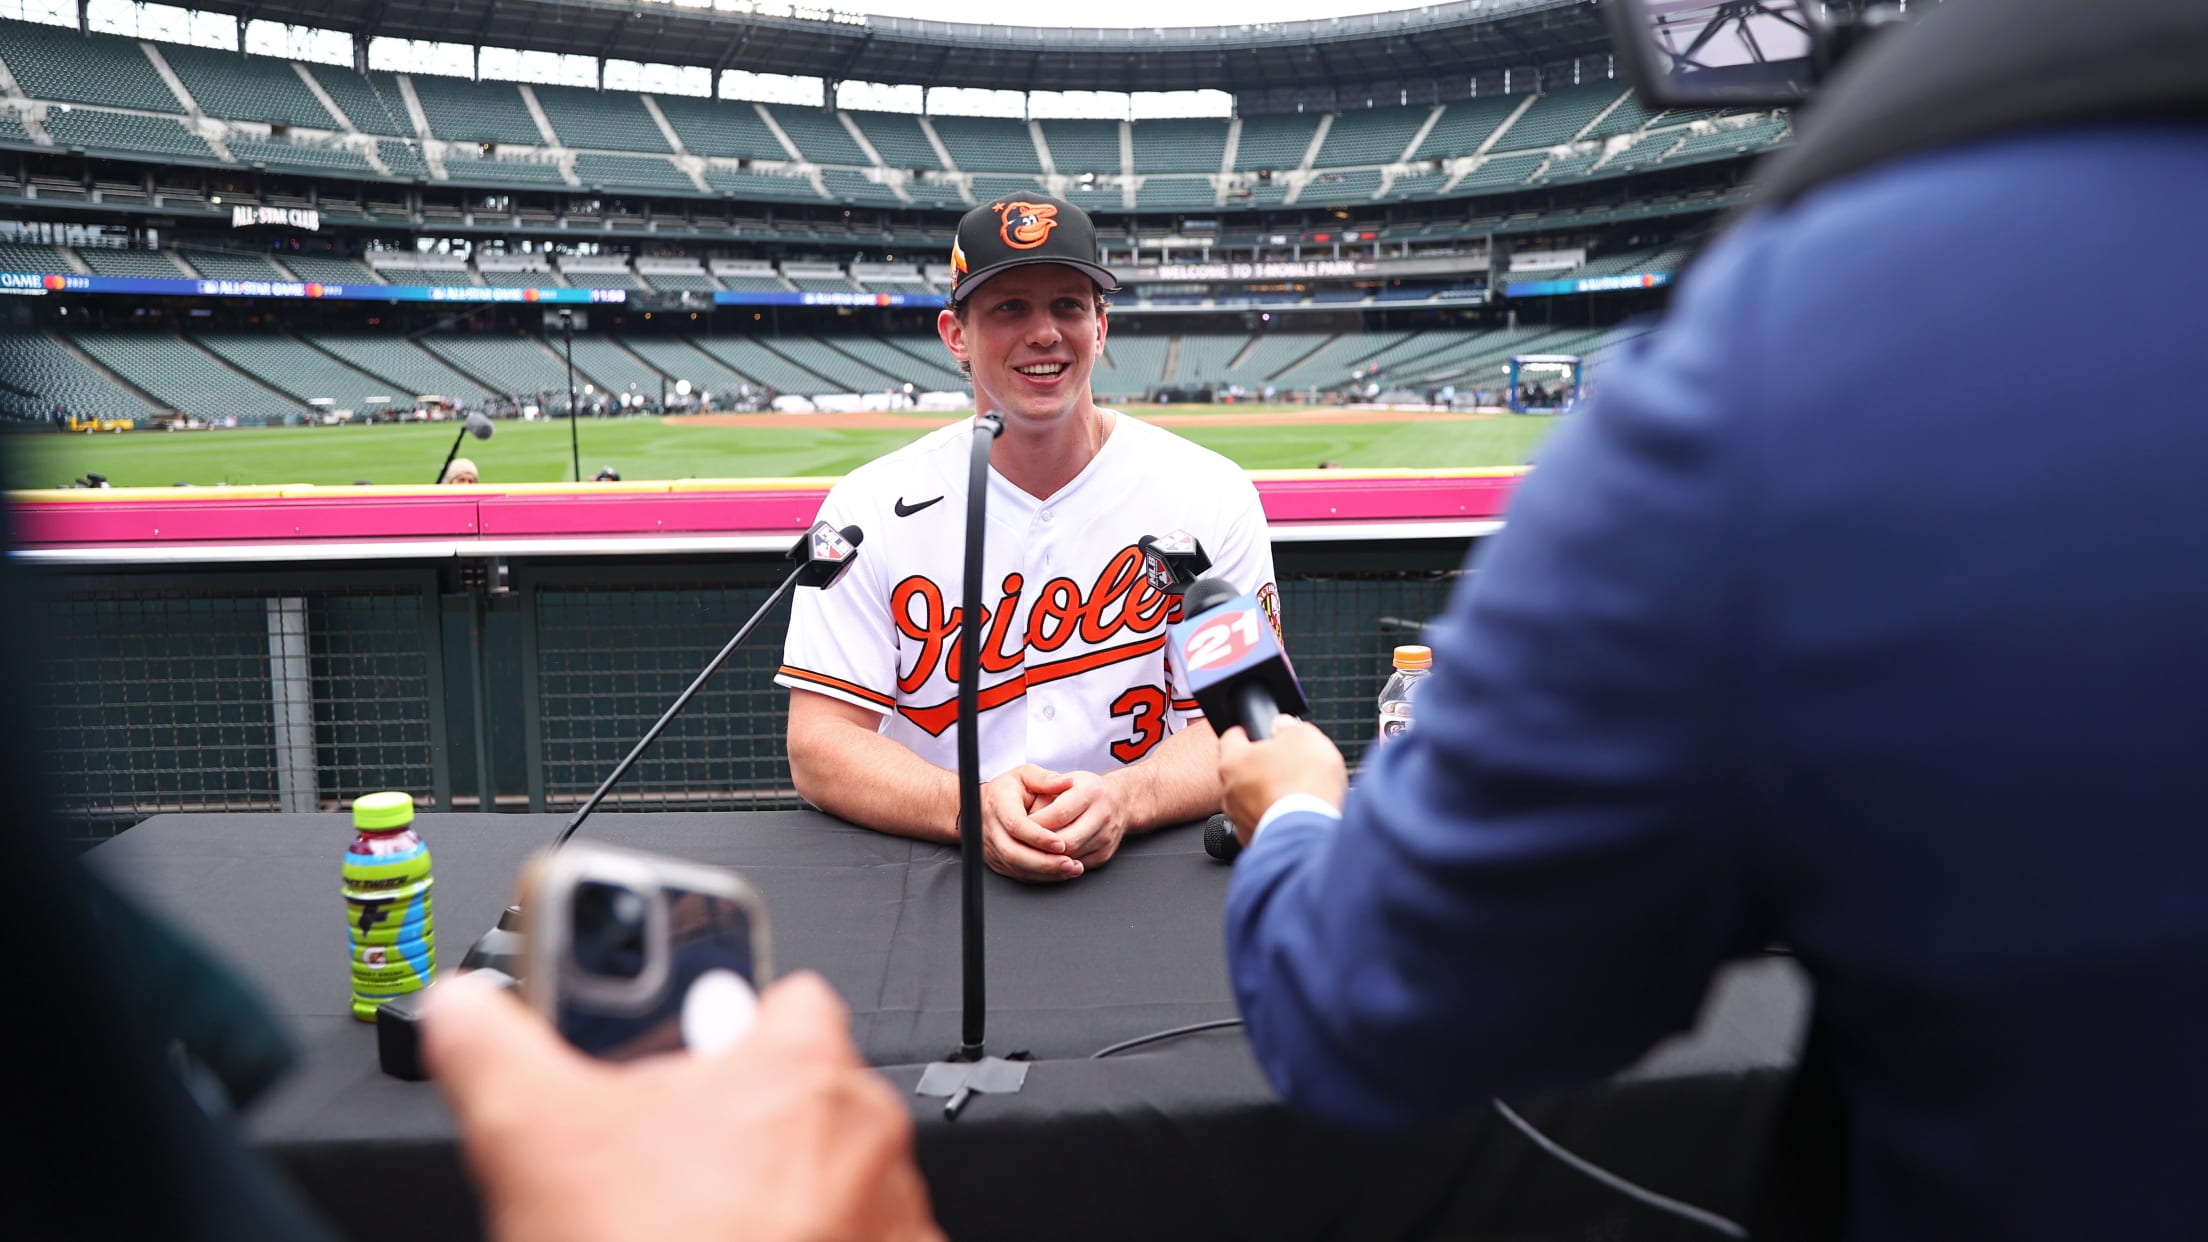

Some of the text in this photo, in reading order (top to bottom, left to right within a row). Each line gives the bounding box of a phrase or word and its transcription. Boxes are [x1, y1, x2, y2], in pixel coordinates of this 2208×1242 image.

[288, 209, 320, 231] CLUB
[0, 273, 42, 289] GAME
[1158, 261, 1356, 280] WELCOME TO T-MOBILE PARK
[271, 282, 305, 297] GAME
[1148, 555, 1158, 586] MLB
[1187, 608, 1260, 672] 21
[1110, 684, 1172, 765] 3
[362, 946, 388, 970] G
